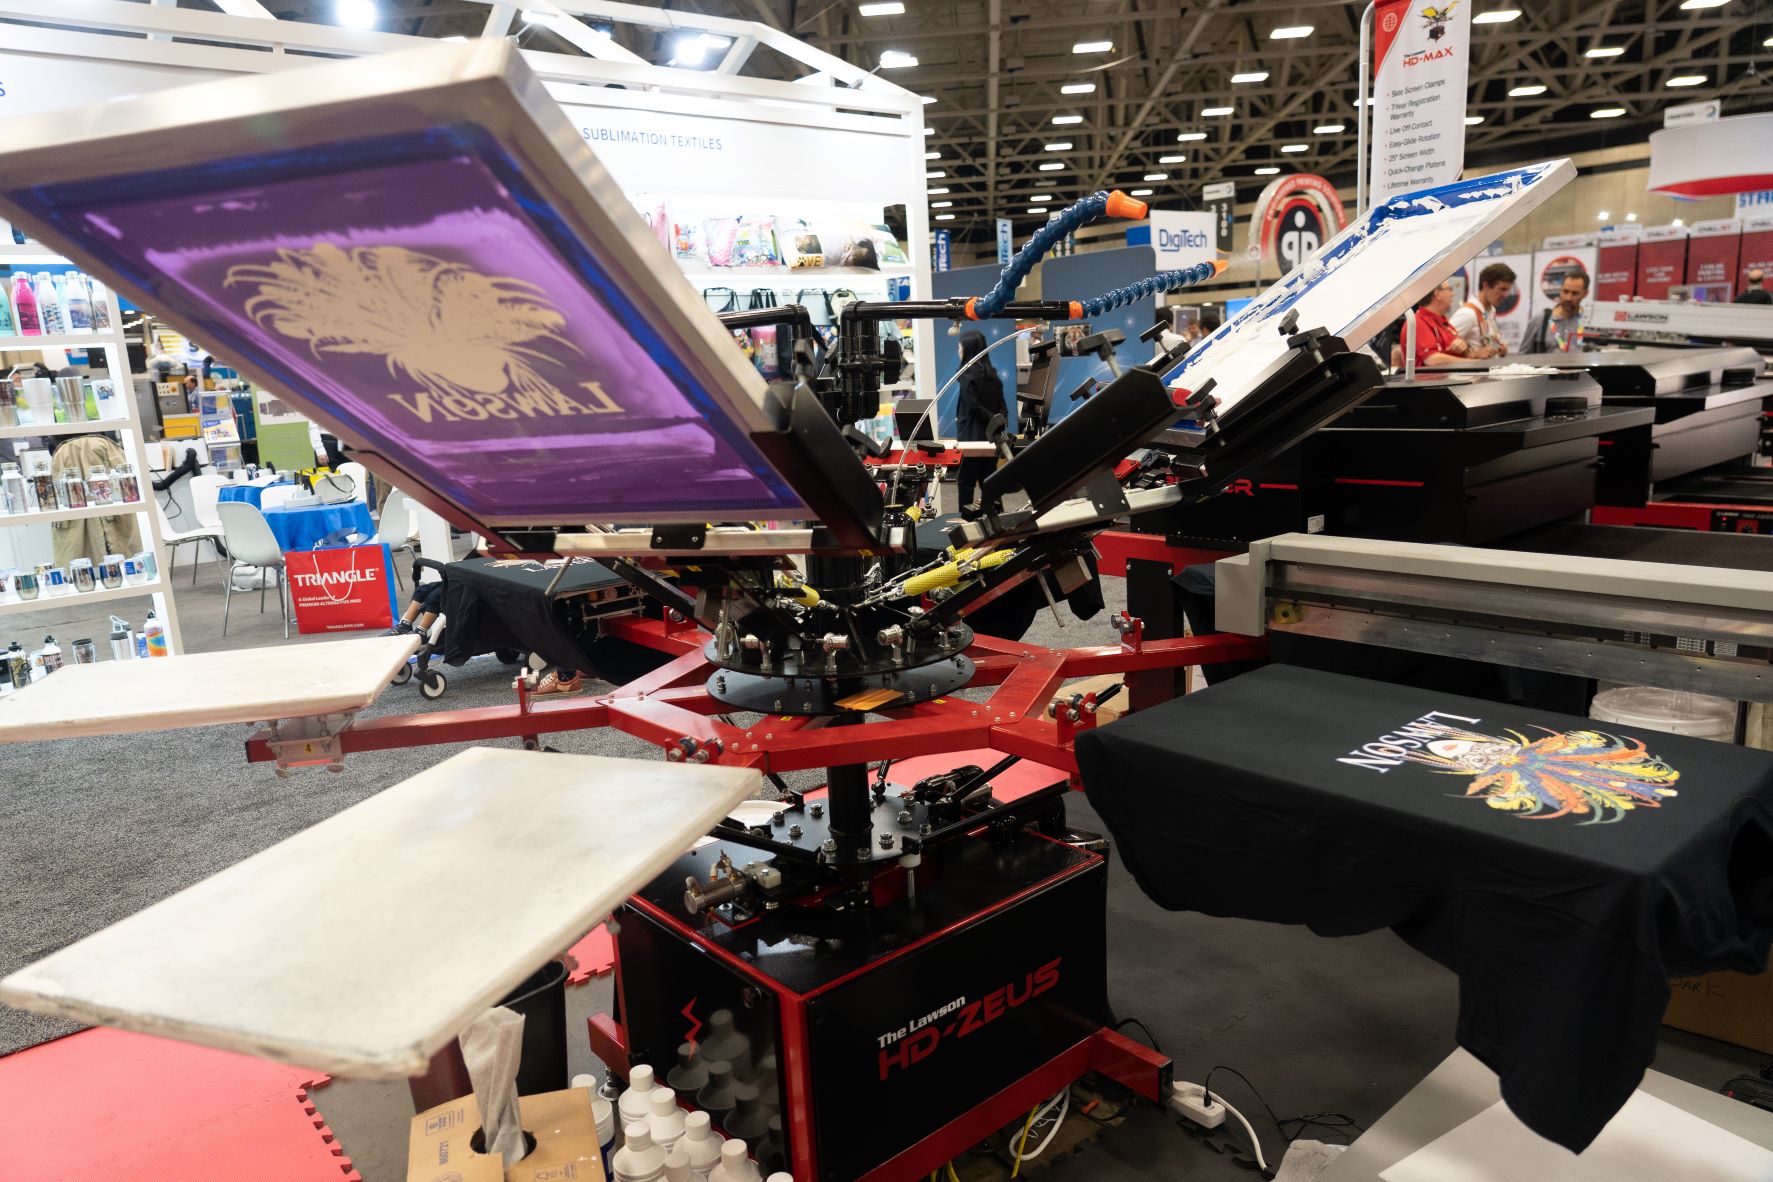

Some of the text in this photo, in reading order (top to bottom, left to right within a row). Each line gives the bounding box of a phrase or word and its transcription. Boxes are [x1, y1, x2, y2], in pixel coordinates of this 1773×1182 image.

[1403, 46, 1453, 68] HD-MAX
[1391, 79, 1446, 98] Side Screen Clamps
[1408, 94, 1441, 107] Registration
[1390, 110, 1414, 121] Warranty
[582, 127, 723, 150] SUBLIMATION TEXTILES
[1389, 127, 1401, 135] Live
[1418, 133, 1441, 143] Rotation
[1399, 151, 1418, 161] Screen
[1419, 148, 1435, 157] Width
[1388, 164, 1425, 176] Quick-Change
[1387, 176, 1434, 190] Lifetime Warranty
[1159, 228, 1208, 252] DigiTech
[294, 568, 377, 587] TRIANGLE
[1335, 710, 1483, 774] LAWSON
[877, 996, 966, 1048] The Lawson
[878, 956, 1063, 1081] HD-ZEUS
